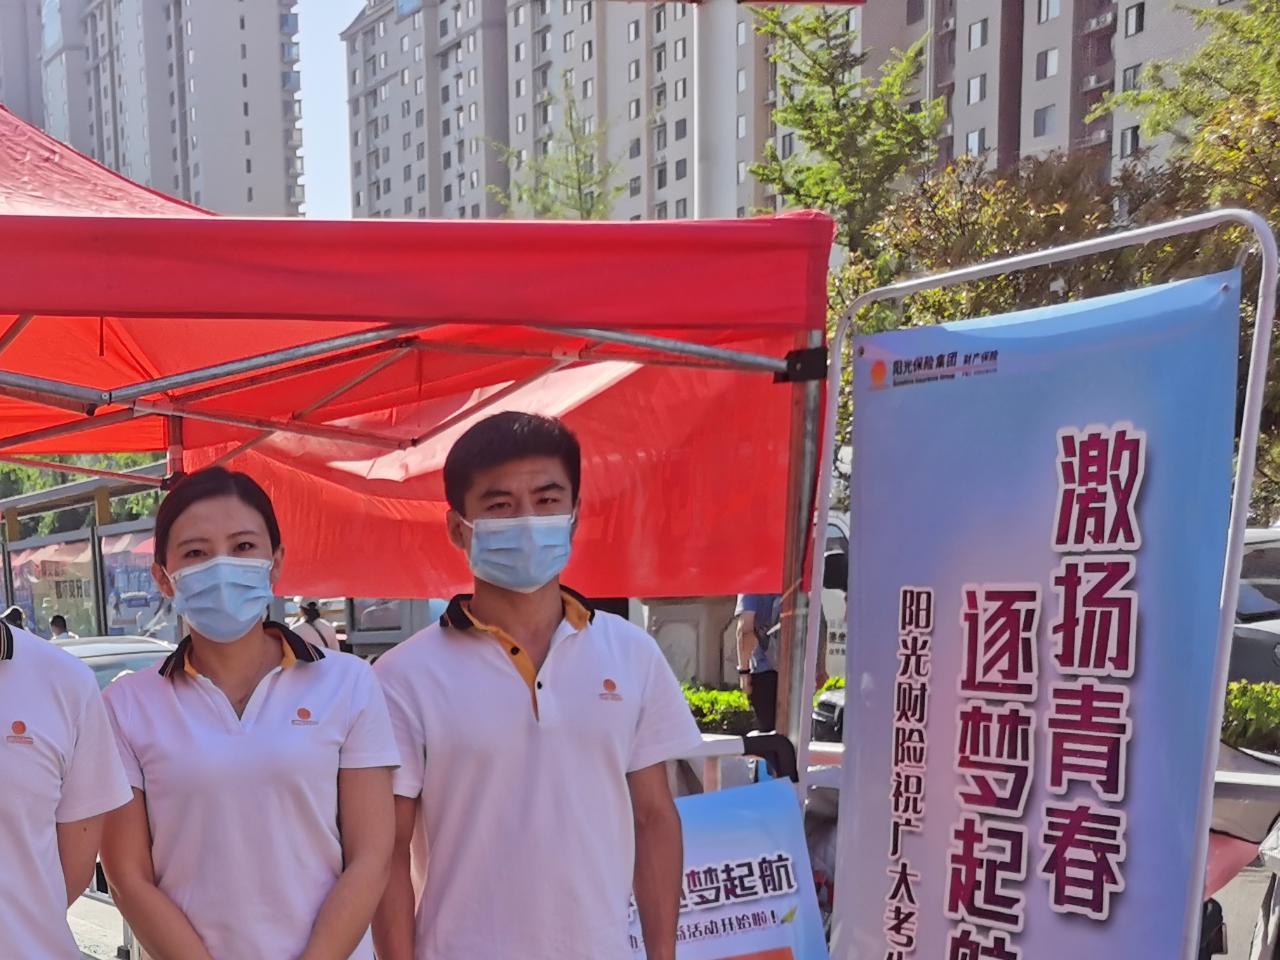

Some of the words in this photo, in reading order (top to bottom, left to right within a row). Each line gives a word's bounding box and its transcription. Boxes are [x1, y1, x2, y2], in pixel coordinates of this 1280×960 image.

[892, 351, 958, 377] 阳光保险集团
[1040, 427, 1143, 917] 激扬青春
[679, 853, 795, 908] 梦起航
